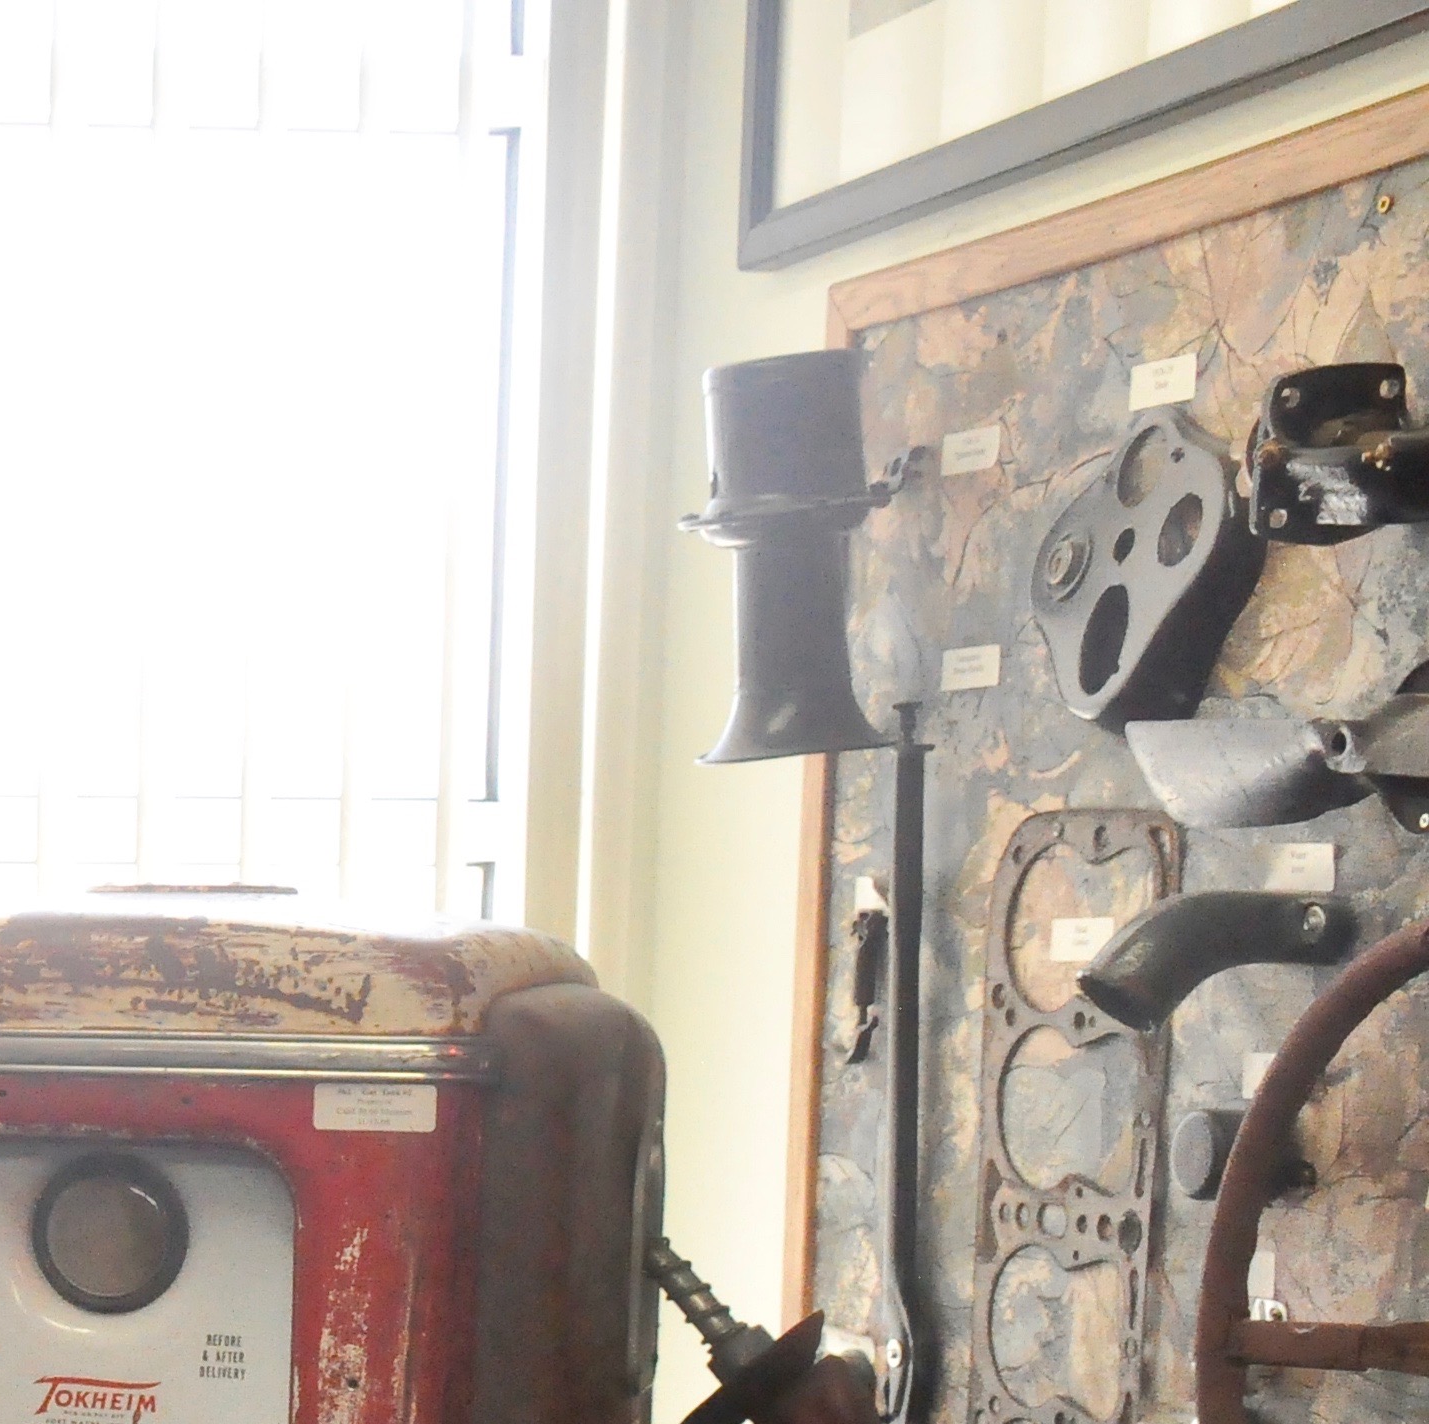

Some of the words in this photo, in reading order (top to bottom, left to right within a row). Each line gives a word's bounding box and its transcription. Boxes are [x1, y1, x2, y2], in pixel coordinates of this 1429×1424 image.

[205, 1334, 243, 1348] BEFORE
[215, 1351, 246, 1364] AFTER
[198, 1366, 247, 1380] DELIVERY
[33, 1375, 162, 1416] TOKHEIM
